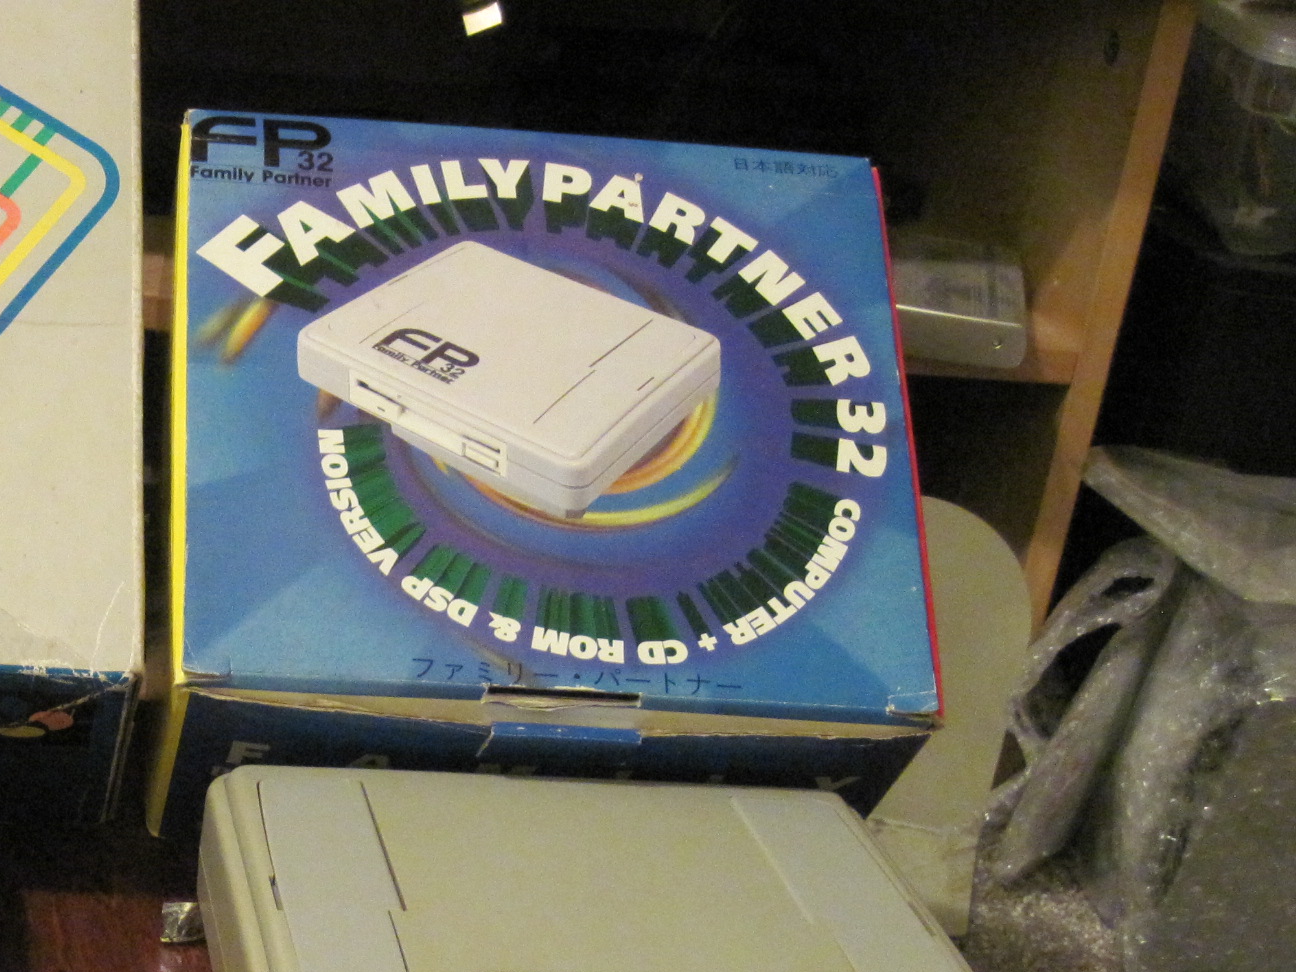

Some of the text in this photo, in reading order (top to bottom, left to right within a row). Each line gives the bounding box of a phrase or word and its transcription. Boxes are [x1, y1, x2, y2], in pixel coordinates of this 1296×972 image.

[191, 116, 331, 167] FP
[191, 165, 332, 187] Family Partner
[298, 150, 334, 172] 32
[196, 158, 887, 478] FAMILY PARTNER 32
[372, 328, 480, 367] FP
[440, 363, 465, 379] 32
[317, 429, 397, 575] VERSION
[724, 498, 860, 646] COMPUTER
[401, 575, 479, 627] DSP
[489, 611, 521, 643] &
[531, 627, 624, 663] ROM
[638, 638, 688, 664] CD
[413, 657, 742, 692] ファミリー・パートナー
